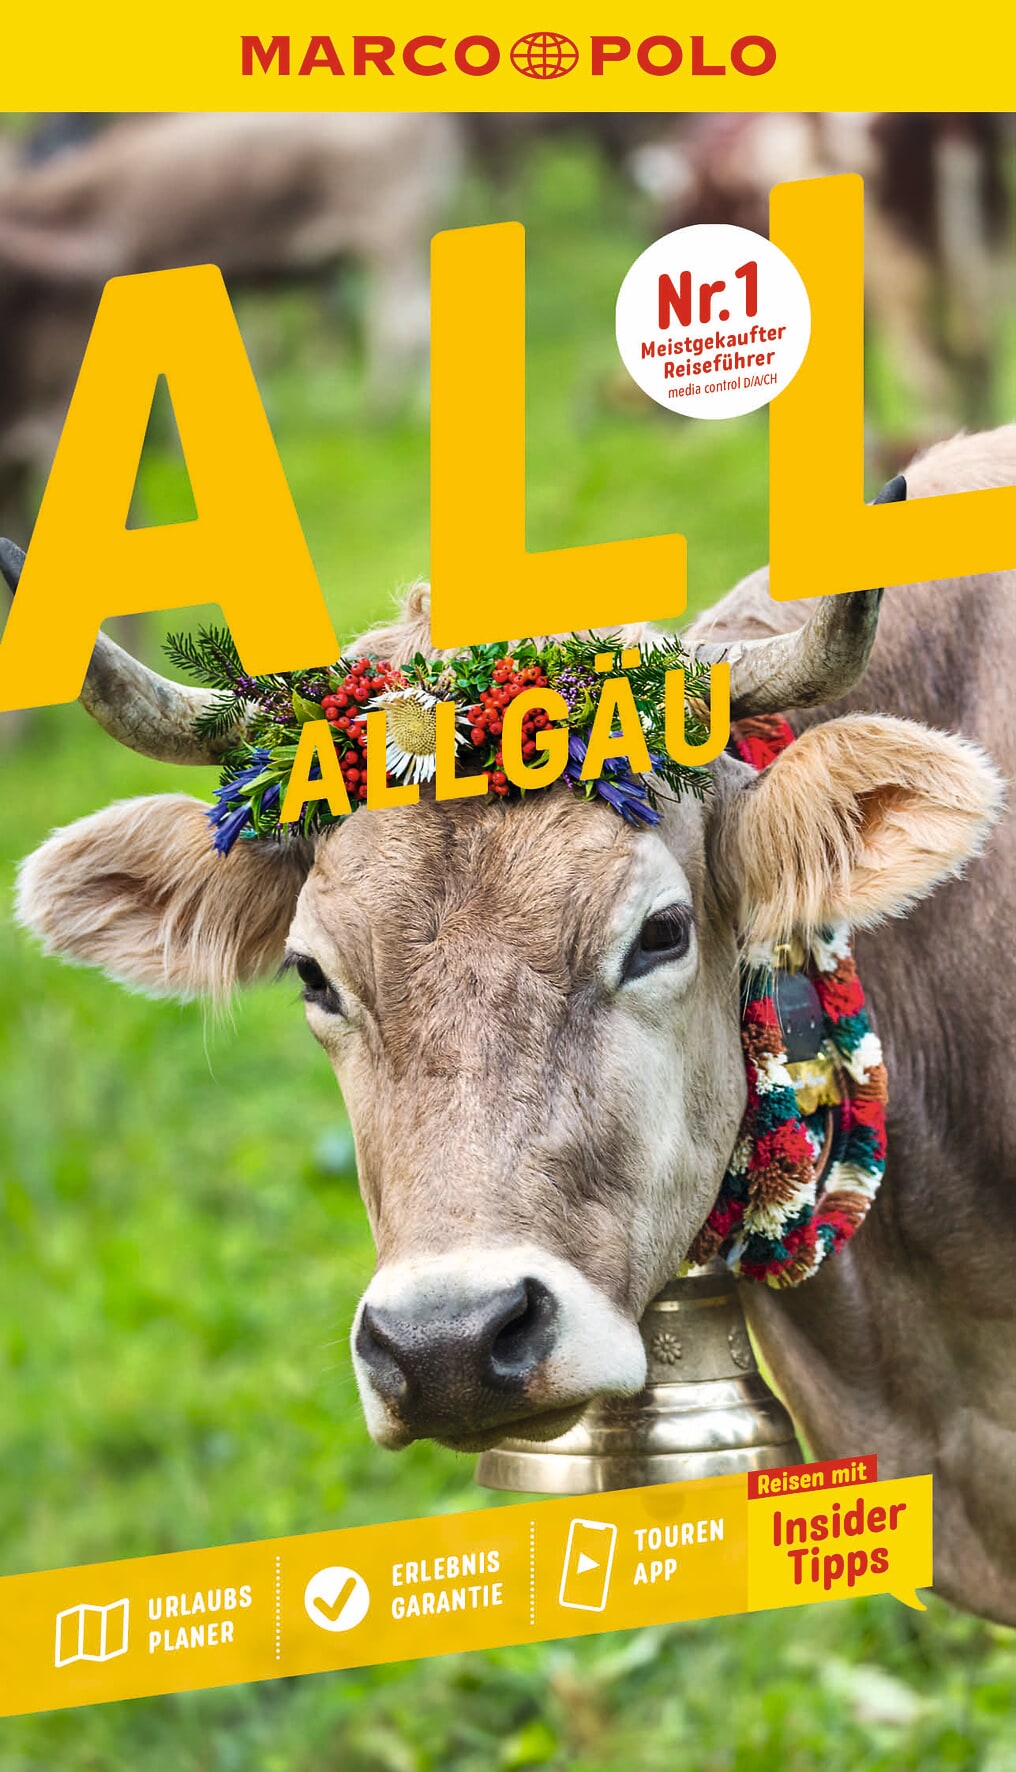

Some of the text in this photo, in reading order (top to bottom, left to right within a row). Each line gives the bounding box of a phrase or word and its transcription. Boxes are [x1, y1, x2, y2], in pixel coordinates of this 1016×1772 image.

[241, 35, 777, 77] MARCO POLO
[641, 325, 787, 359] Meistgekaufter
[664, 351, 776, 379] Reiseführer
[668, 373, 778, 398] media control D/A/CH
[280, 649, 731, 824] ALLGÄU
[758, 1462, 867, 1495] Reisen mit
[634, 1519, 725, 1552] TOUREN
[773, 1498, 907, 1547] Insider
[392, 1551, 501, 1586] ERLEBNIS
[633, 1559, 677, 1585] APP
[787, 1547, 890, 1591] Tipps
[148, 1585, 253, 1620] URLAUBS
[392, 1583, 504, 1619] GARANTIE
[149, 1621, 234, 1654] PLANER
